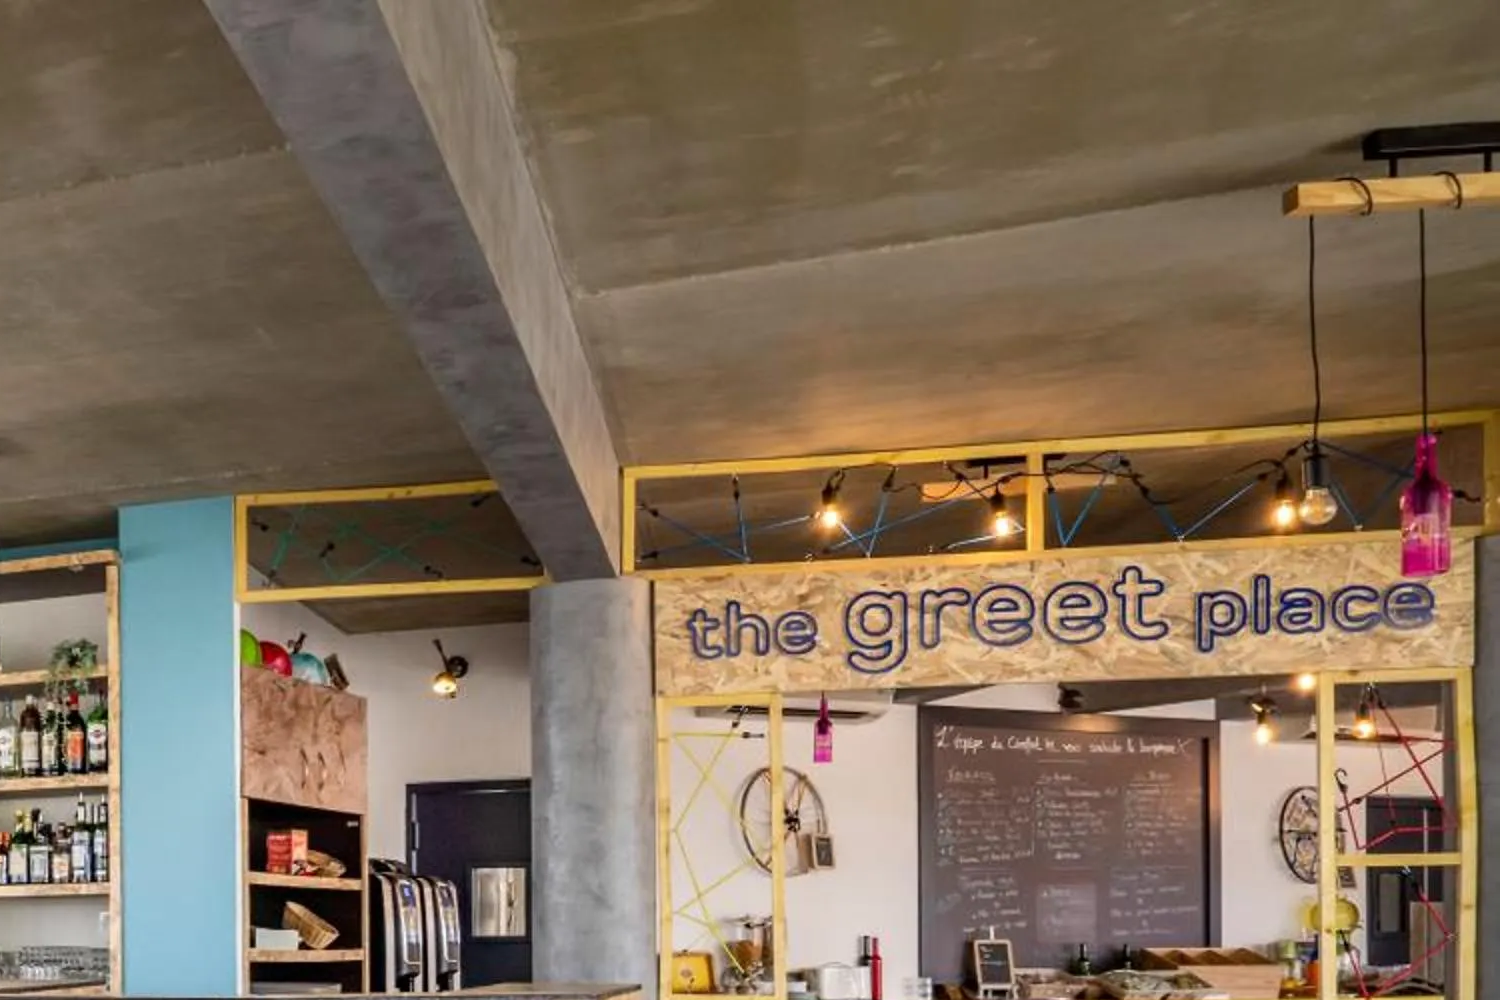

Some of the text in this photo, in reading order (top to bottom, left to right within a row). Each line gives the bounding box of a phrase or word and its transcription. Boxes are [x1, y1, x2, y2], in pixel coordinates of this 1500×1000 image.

[686, 565, 1437, 674] the greet place
